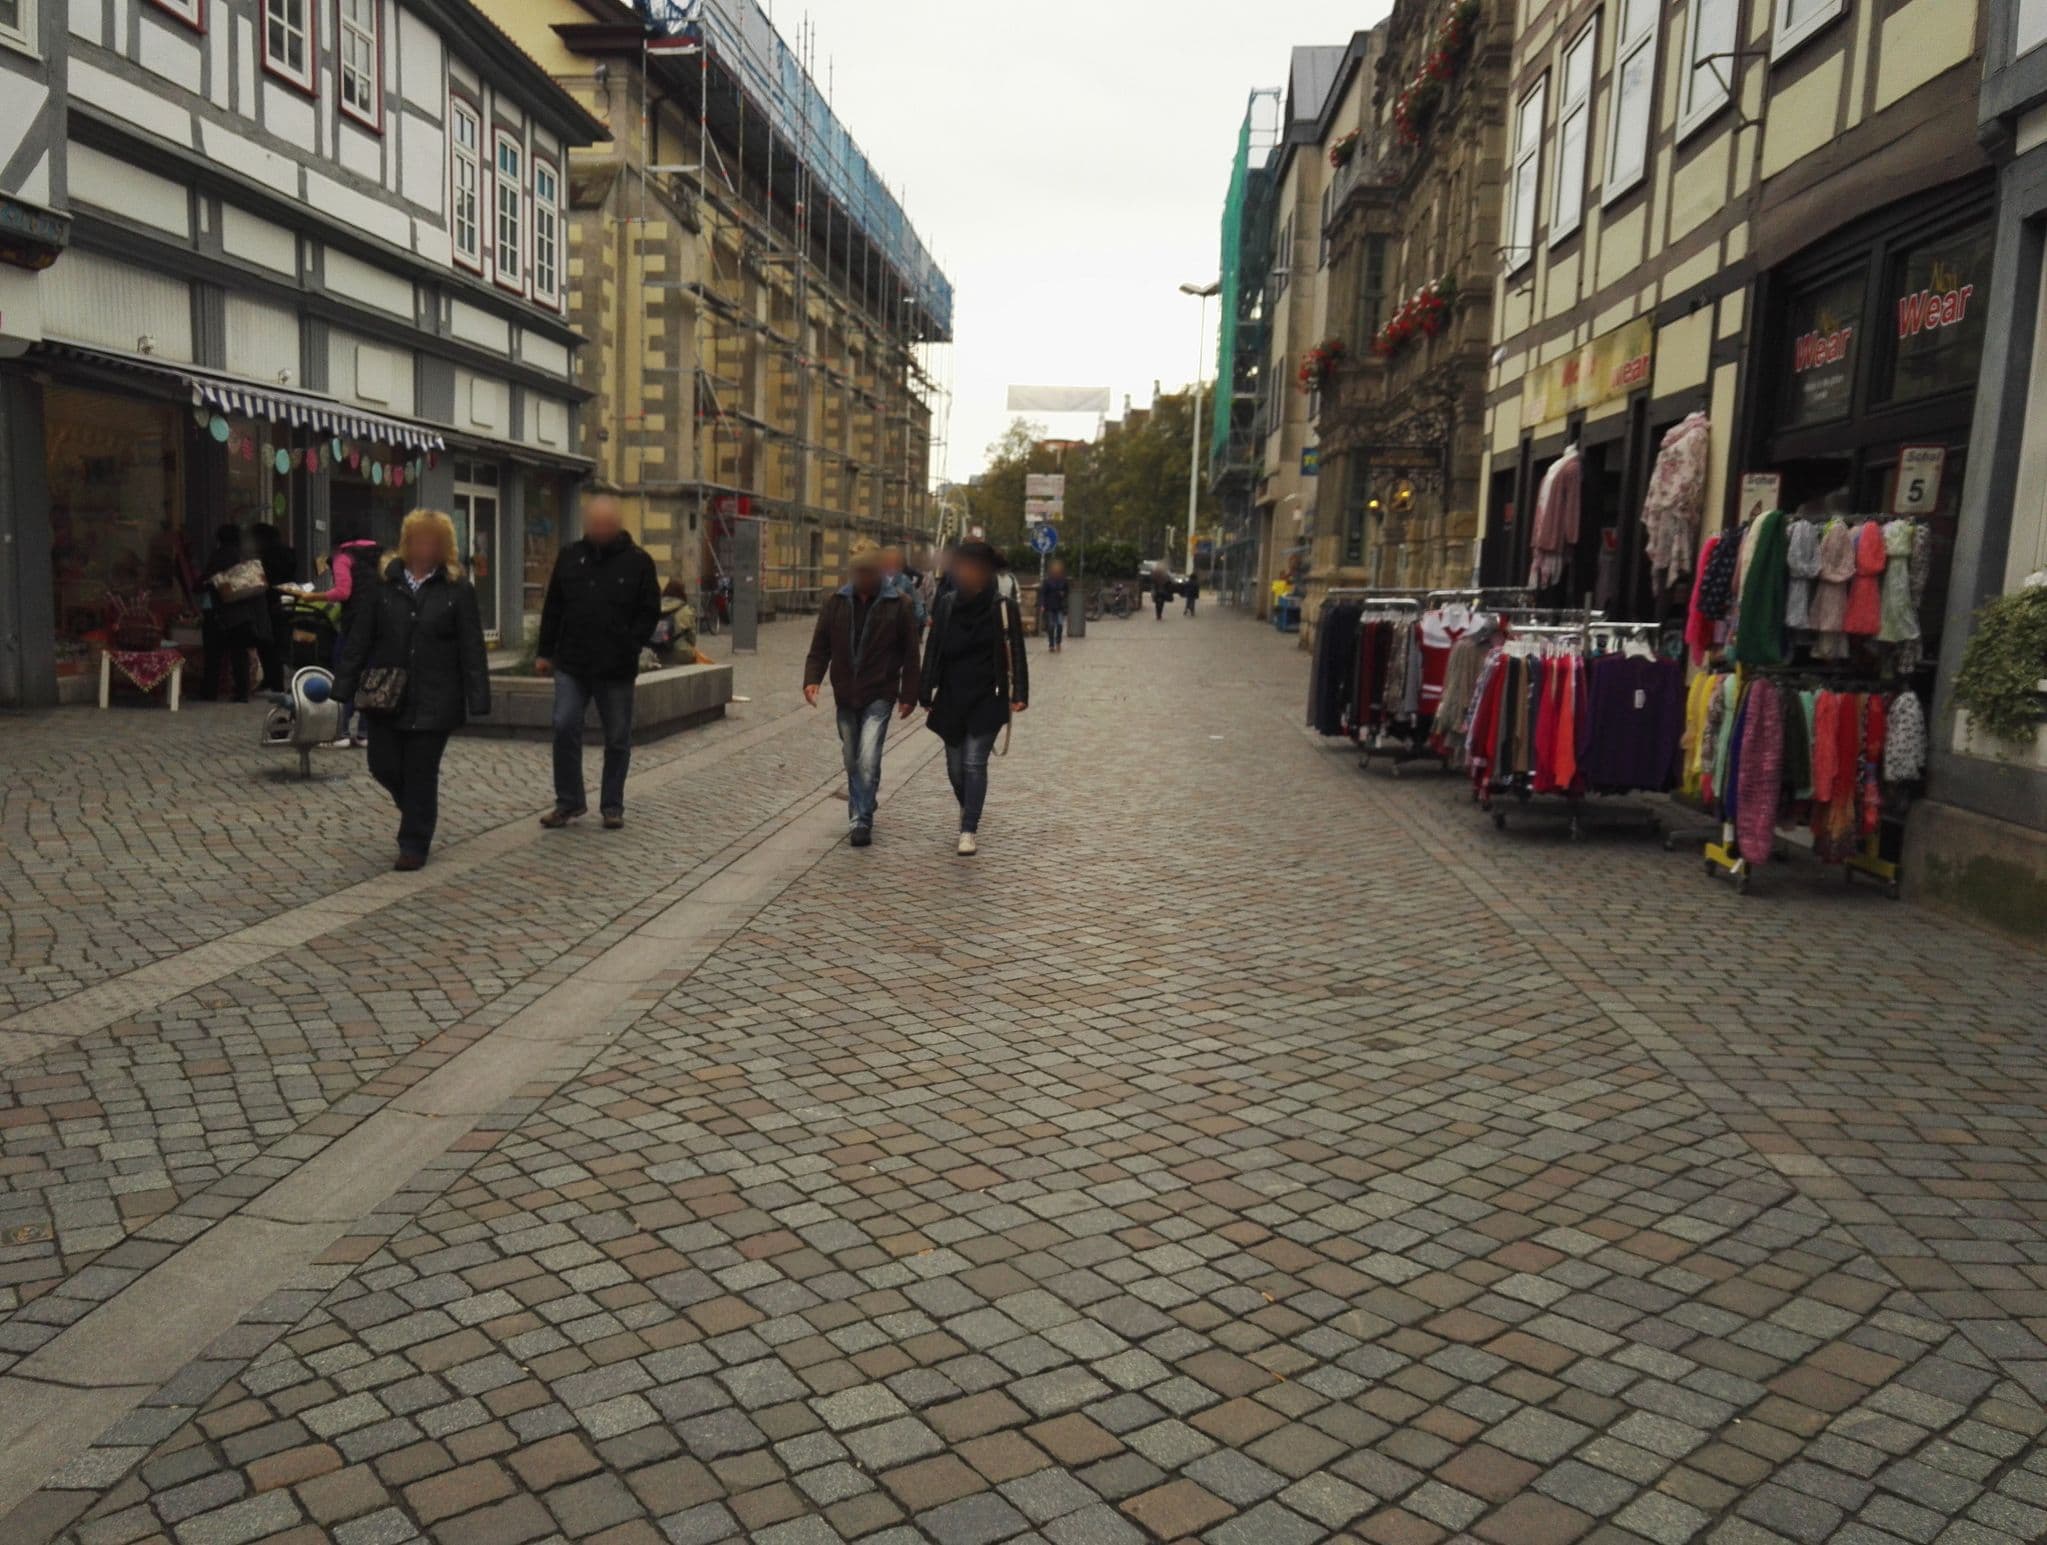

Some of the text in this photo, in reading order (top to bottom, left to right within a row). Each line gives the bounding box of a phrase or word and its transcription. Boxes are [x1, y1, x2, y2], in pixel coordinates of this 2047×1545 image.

[1897, 284, 1974, 340] Wear
[1795, 326, 1853, 373] Wear
[1907, 478, 1926, 503] 5
